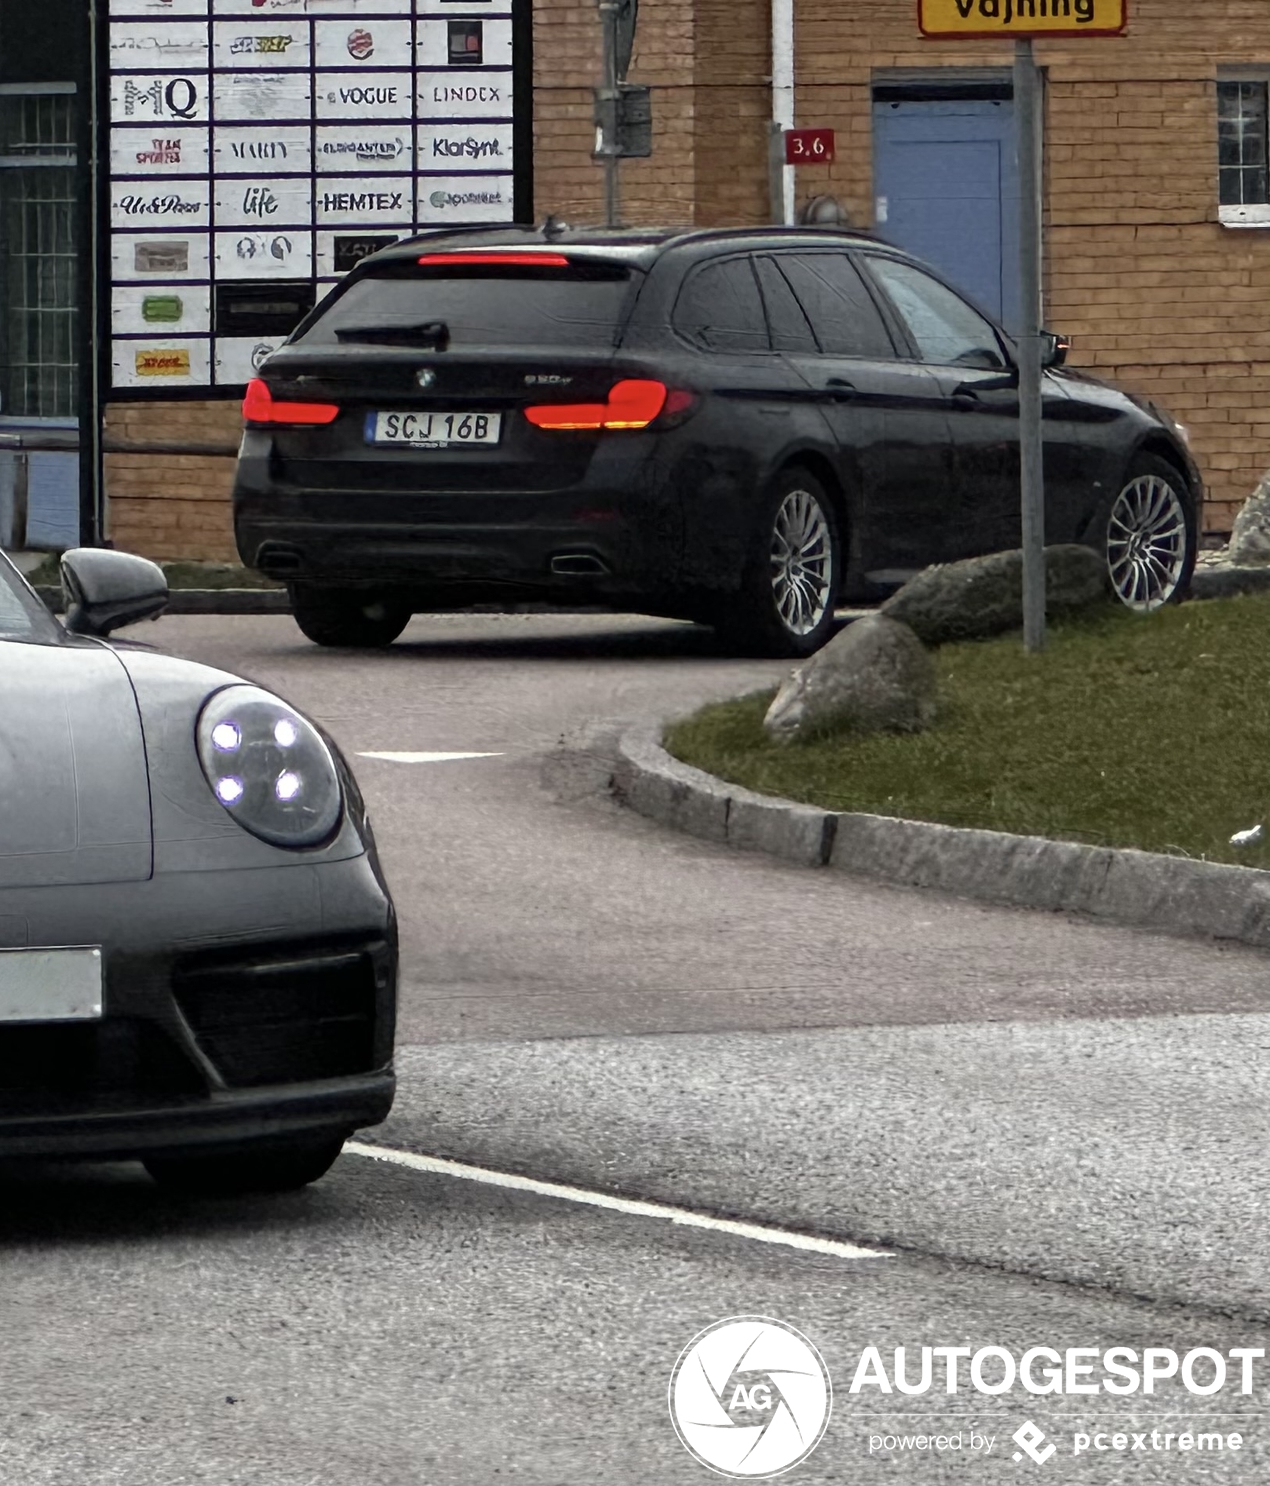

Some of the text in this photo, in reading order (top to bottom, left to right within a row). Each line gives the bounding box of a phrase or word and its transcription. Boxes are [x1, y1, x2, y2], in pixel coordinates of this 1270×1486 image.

[340, 87, 397, 104] VOGUE
[324, 193, 402, 212] HEMTEX
[385, 414, 489, 439] SCJ 16B
